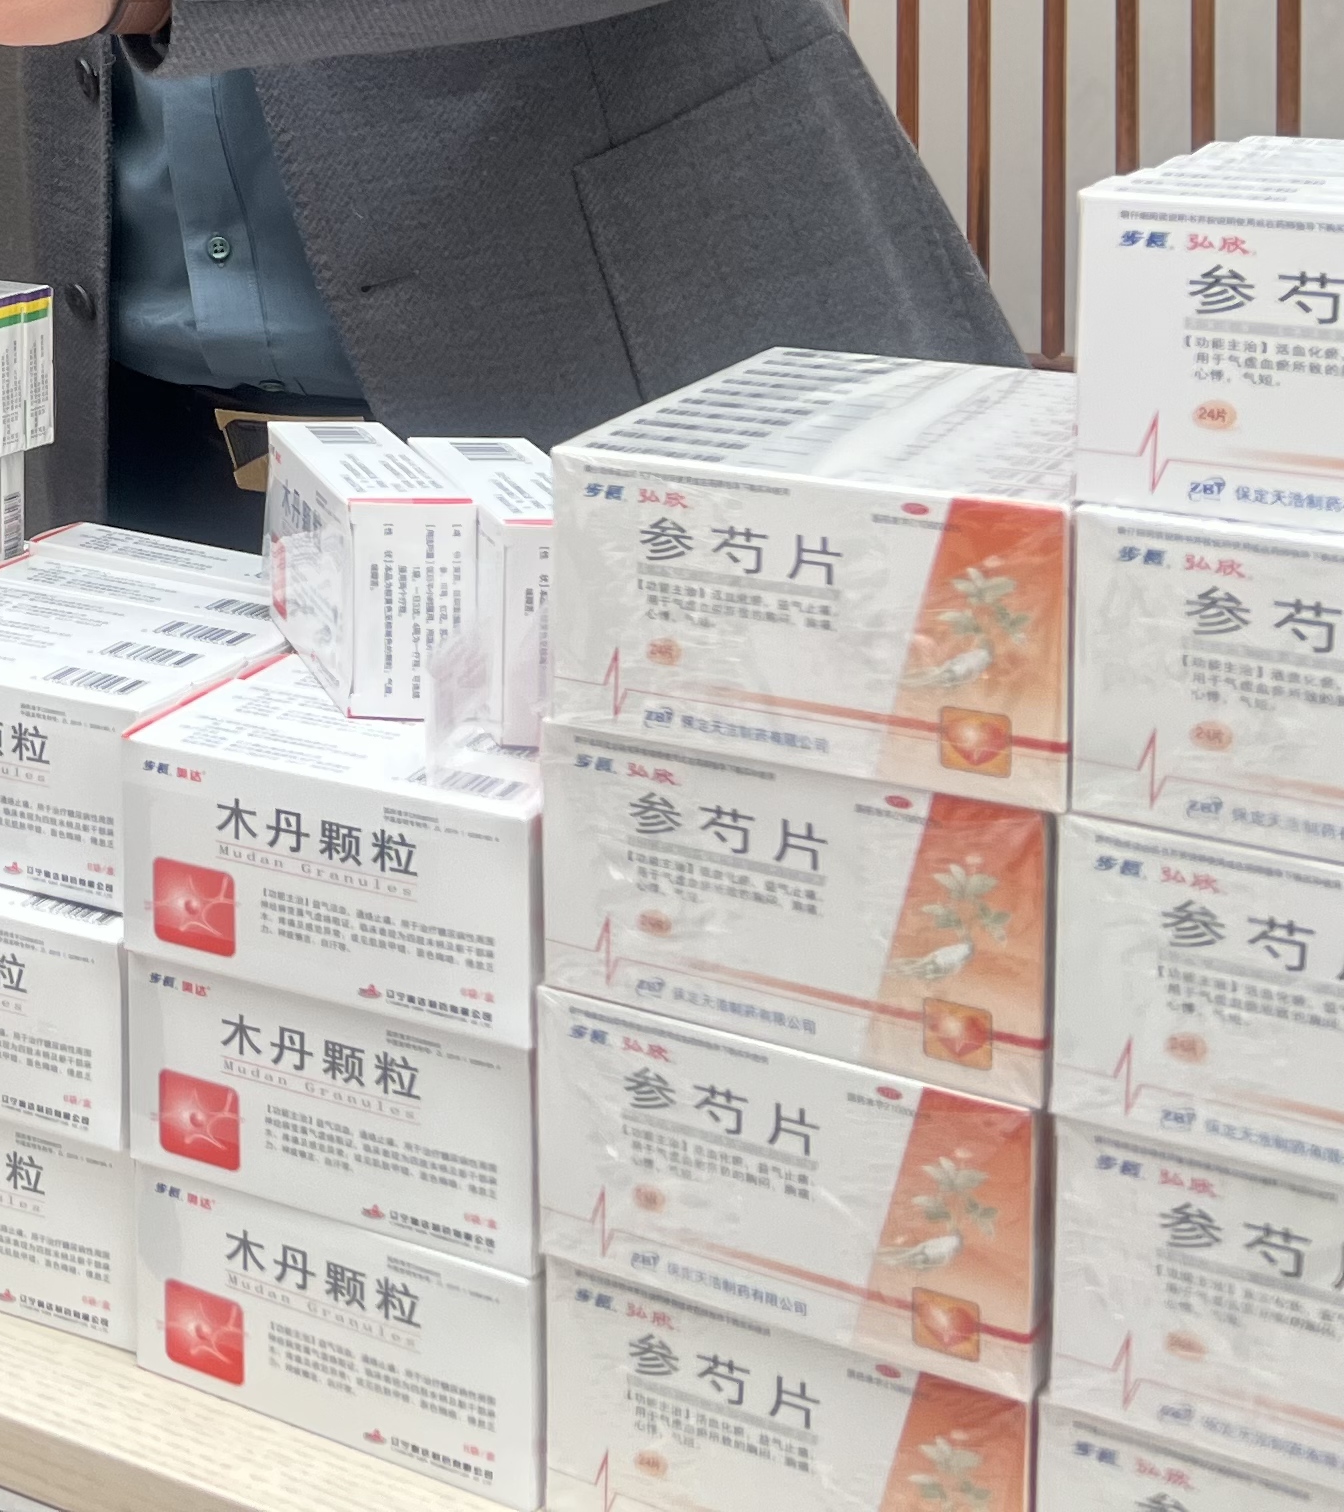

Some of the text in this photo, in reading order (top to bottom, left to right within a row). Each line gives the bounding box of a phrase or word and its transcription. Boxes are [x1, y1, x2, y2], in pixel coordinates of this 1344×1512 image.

[1186, 233, 1251, 256] 弘欣
[1188, 263, 1344, 325] 参芍
[1197, 406, 1228, 423] 24片
[1234, 485, 1344, 513] 保定天浩制药
[639, 516, 845, 587] 参芍片
[1183, 552, 1247, 579] 弘欣
[1185, 585, 1344, 654] 参芍
[215, 797, 419, 877] 木丹颗粒
[627, 790, 829, 872] 参芍片
[218, 844, 414, 897] Mudan Granules
[1161, 898, 1344, 981] 参芍
[220, 1013, 422, 1102] 木丹颗粒
[223, 1058, 418, 1121] Mudan Granules
[622, 1066, 821, 1157] 参芍片
[225, 1228, 422, 1329] 木丹颗粒
[1159, 1201, 1344, 1291] 参芍
[226, 1272, 418, 1351] Mudan Granules
[627, 1332, 821, 1431] 参芍片
